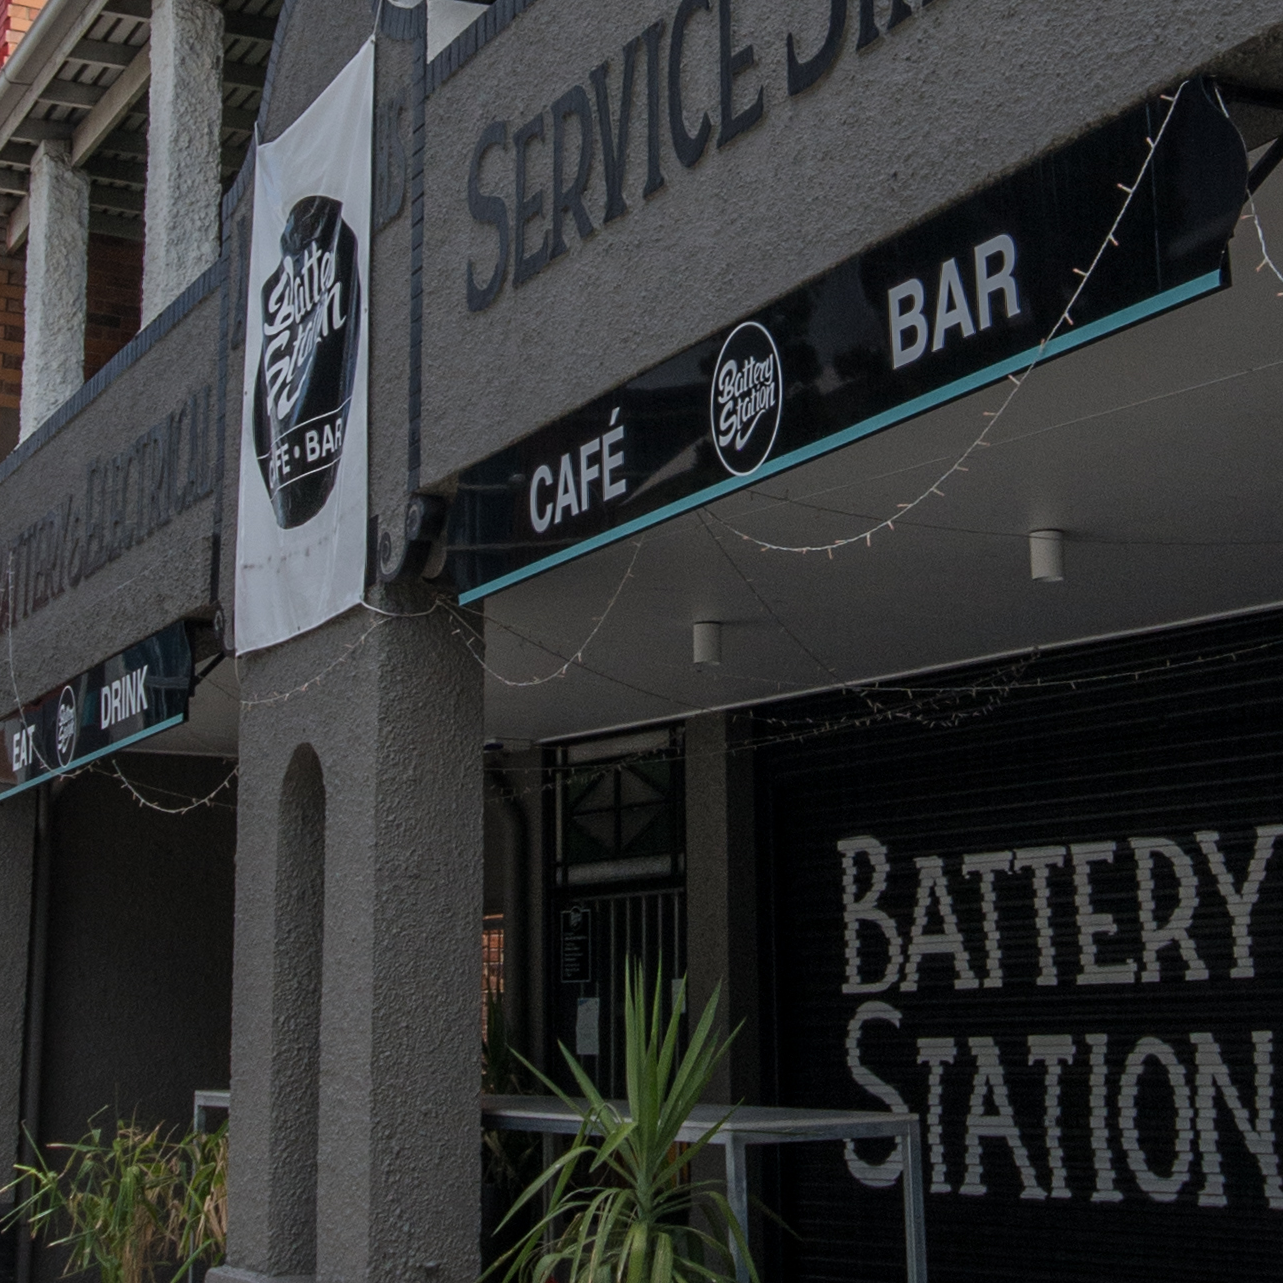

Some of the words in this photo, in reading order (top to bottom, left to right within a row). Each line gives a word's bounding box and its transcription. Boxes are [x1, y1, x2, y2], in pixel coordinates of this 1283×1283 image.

[529, 406, 627, 534] CAFÉ
[887, 233, 1021, 371] BAR
[717, 353, 775, 403] Battery
[305, 418, 343, 463] BAR
[718, 382, 776, 450] Station
[12, 724, 36, 772] EAT
[100, 664, 148, 730] DRINK
